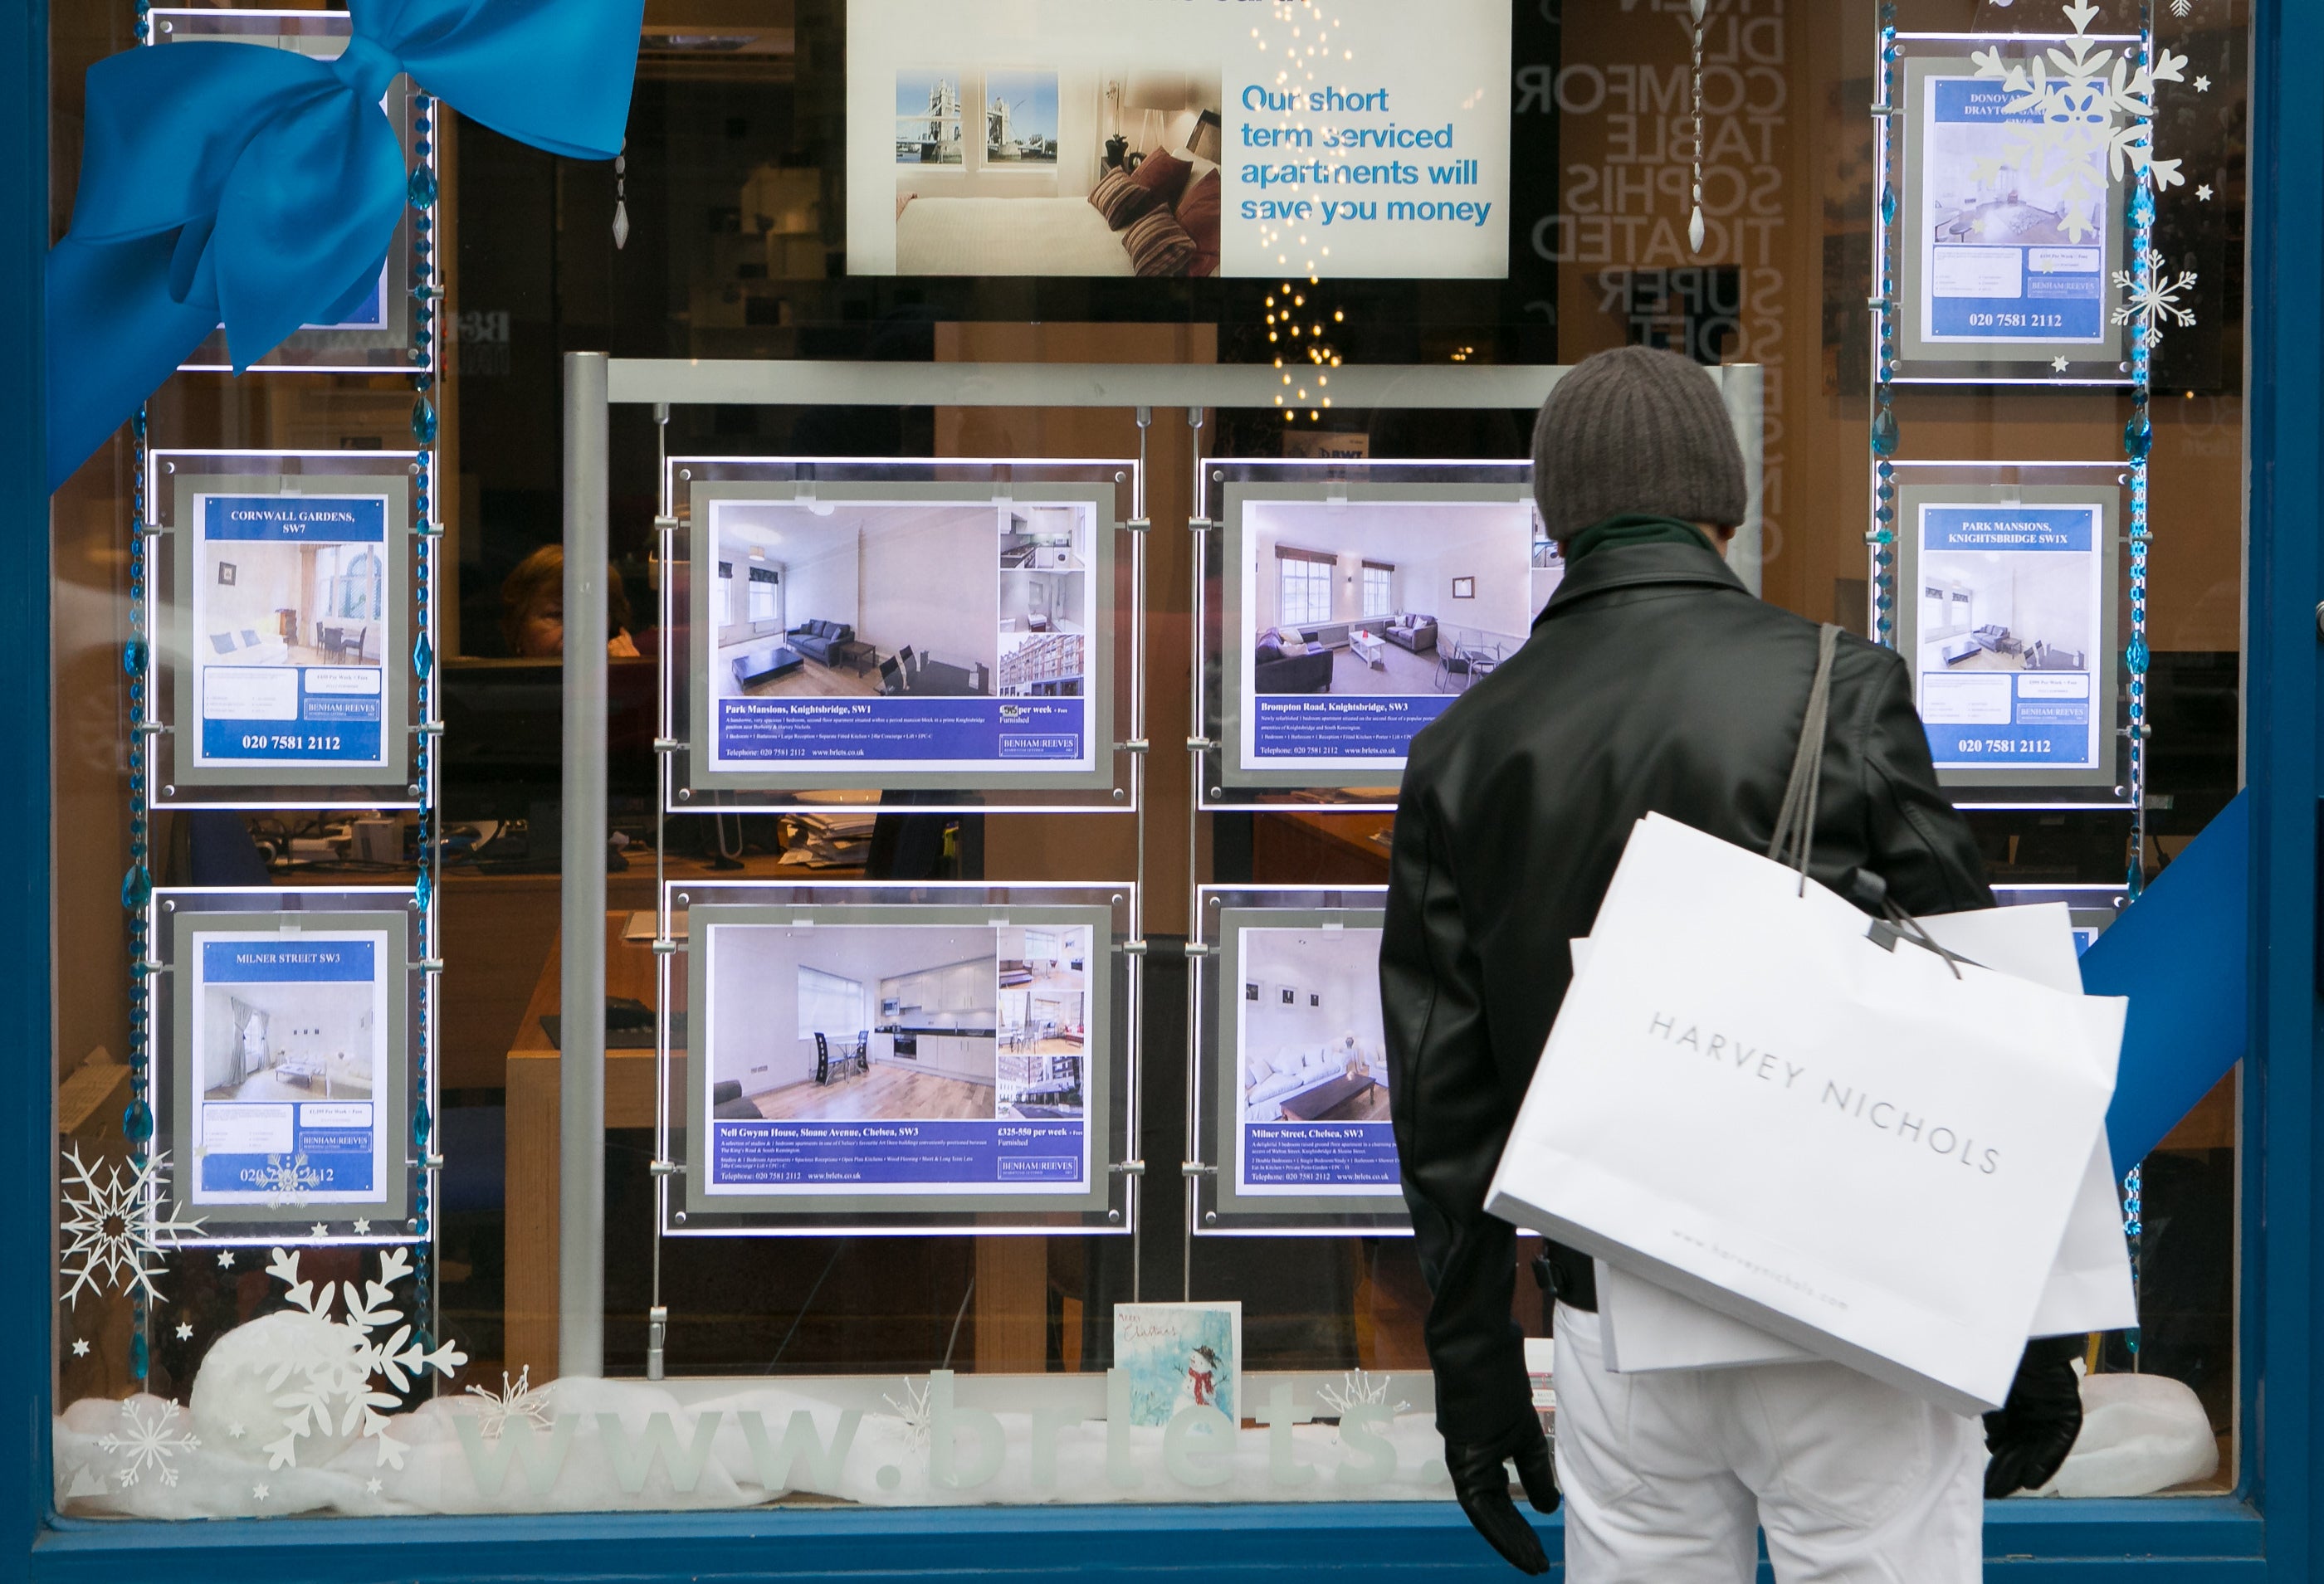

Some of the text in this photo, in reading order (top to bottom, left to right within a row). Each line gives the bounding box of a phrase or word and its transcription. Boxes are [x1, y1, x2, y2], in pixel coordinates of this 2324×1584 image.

[1242, 85, 1389, 112] Our short
[1241, 123, 1452, 148] term serviced
[1241, 159, 1478, 189] apartments will
[1241, 200, 1492, 227] save you money
[1970, 314, 2062, 327] 020 7581 2112
[232, 511, 355, 523] CORNWALL GARDENS,
[283, 524, 305, 534] SW7
[1963, 523, 2052, 533] PARK MANSIONS,
[1949, 534, 2068, 543] KNIGHTSBRIDGE SW1X
[748, 706, 788, 714] Mansions,
[790, 706, 850, 715] Knightsbridge,
[1262, 703, 1408, 713] Brompton Road, Knightsbridge, SW3
[242, 735, 340, 749] 020 7581 2112
[1959, 740, 2051, 753] 020 7581 2112
[726, 749, 757, 758] Telephone:
[1260, 747, 1292, 755] Telephone:
[237, 953, 340, 963] MILNER STREET SW3
[1648, 1011, 1999, 1174] HARVEY NICHOLS
[720, 1128, 919, 1139] Nell Gwynn House, Sloane Avenue, Chelsea, SW3
[1048, 1128, 1067, 1136] week
[1252, 1129, 1364, 1138] Milner Street, Chelsea, SW3
[240, 1168, 264, 1182] 020
[721, 1172, 754, 1182] Telephone:
[1252, 1173, 1284, 1182] Telephone:
[452, 1368, 1447, 1495] www.brlets.
